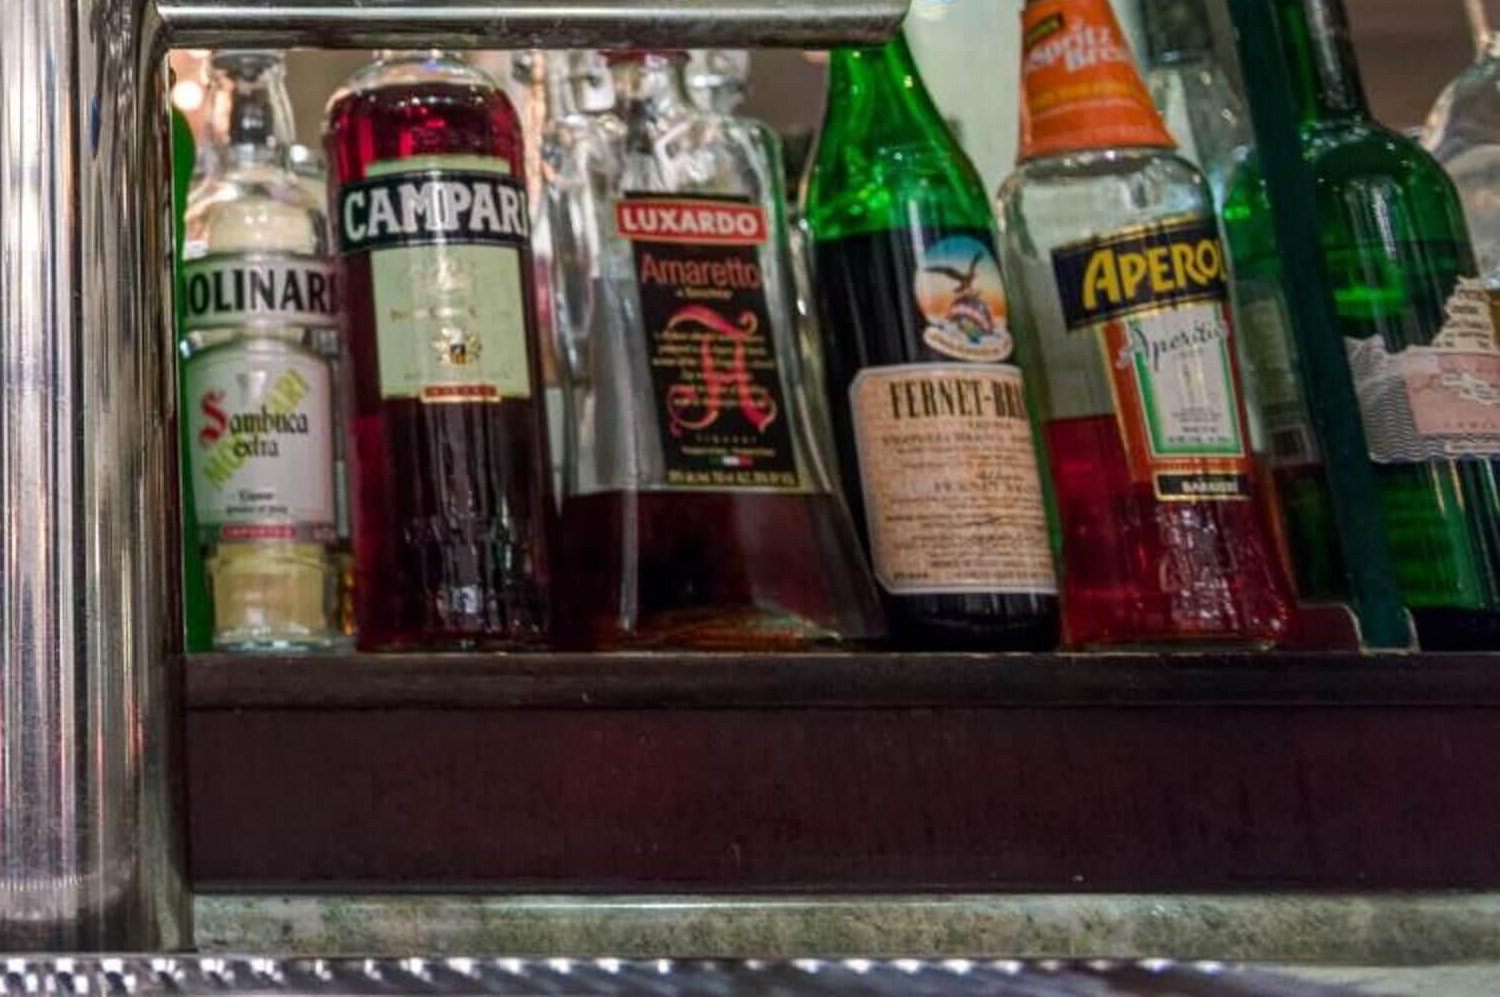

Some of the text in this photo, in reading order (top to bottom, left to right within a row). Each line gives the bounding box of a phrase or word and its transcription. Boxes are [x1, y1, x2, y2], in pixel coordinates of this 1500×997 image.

[342, 172, 530, 241] CAMPARI
[621, 207, 759, 236] LUXARDO
[640, 252, 763, 289] Amaretto
[197, 389, 309, 449] Sambuca
[231, 433, 280, 458] extra
